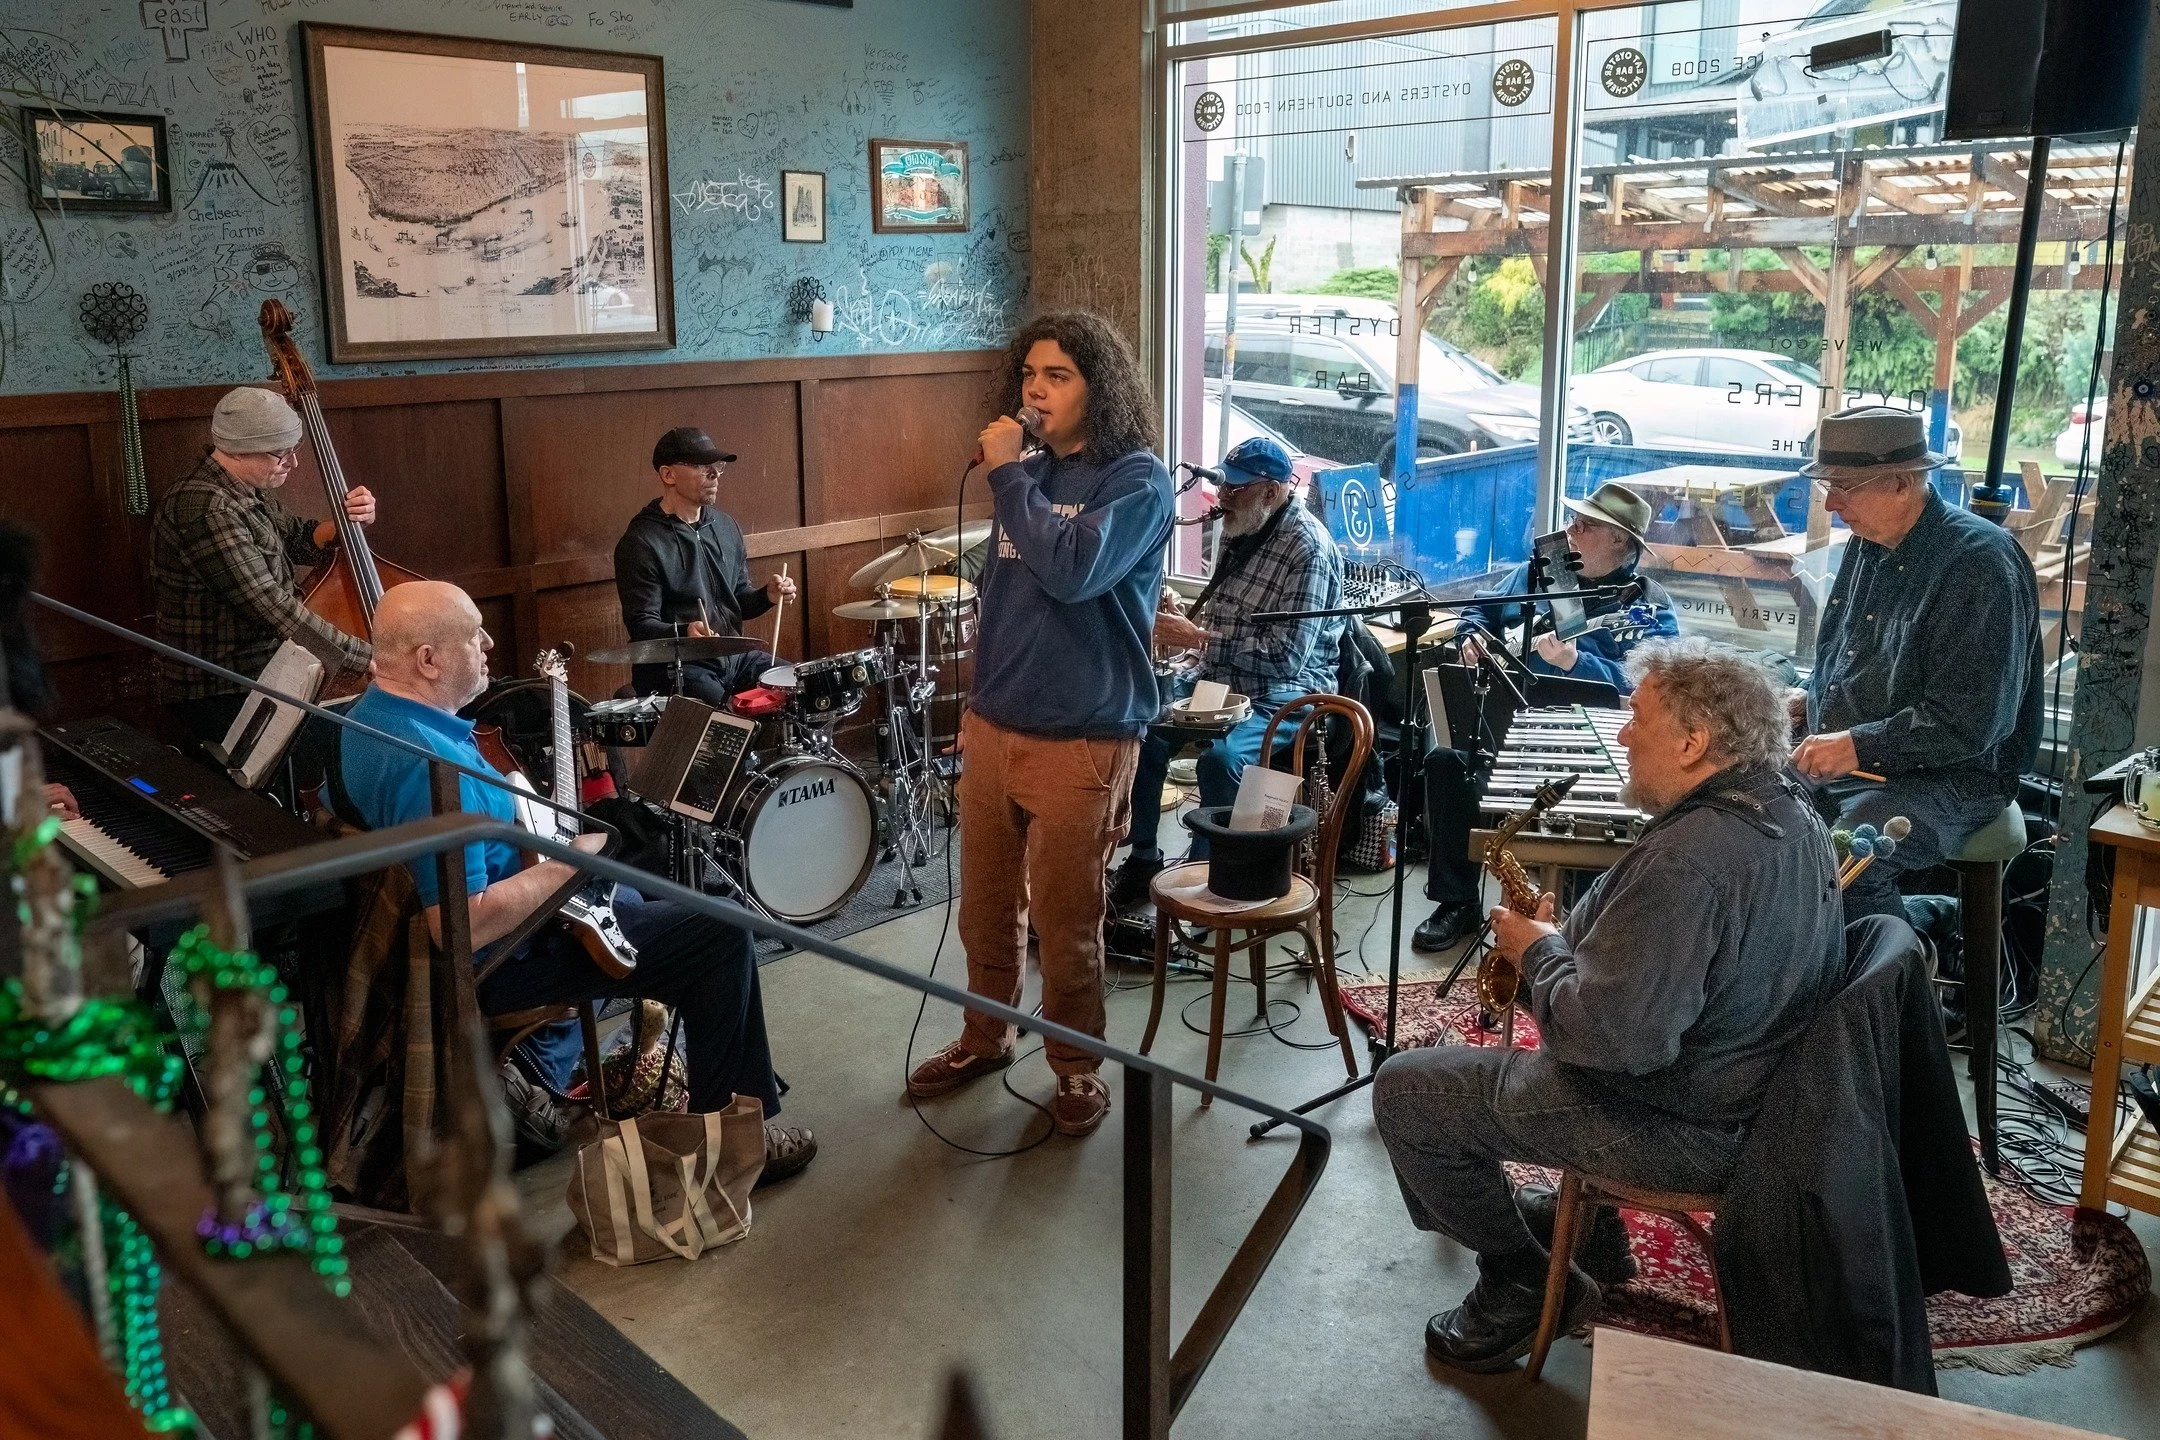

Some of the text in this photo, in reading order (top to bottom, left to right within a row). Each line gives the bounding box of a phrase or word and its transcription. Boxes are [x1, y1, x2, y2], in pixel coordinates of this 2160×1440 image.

[155, 6, 202, 23] east
[509, 12, 543, 25] EARLY
[588, 10, 634, 28] Fo Sho
[237, 26, 277, 45] WHO
[18, 42, 51, 71] FRIENDS
[245, 45, 278, 62] DAT
[864, 42, 909, 63] Versace
[904, 153, 919, 167] Old
[188, 204, 243, 222] Chelsea
[221, 221, 265, 240] Farms
[896, 258, 928, 274] KING
[789, 777, 836, 806] TAMA
